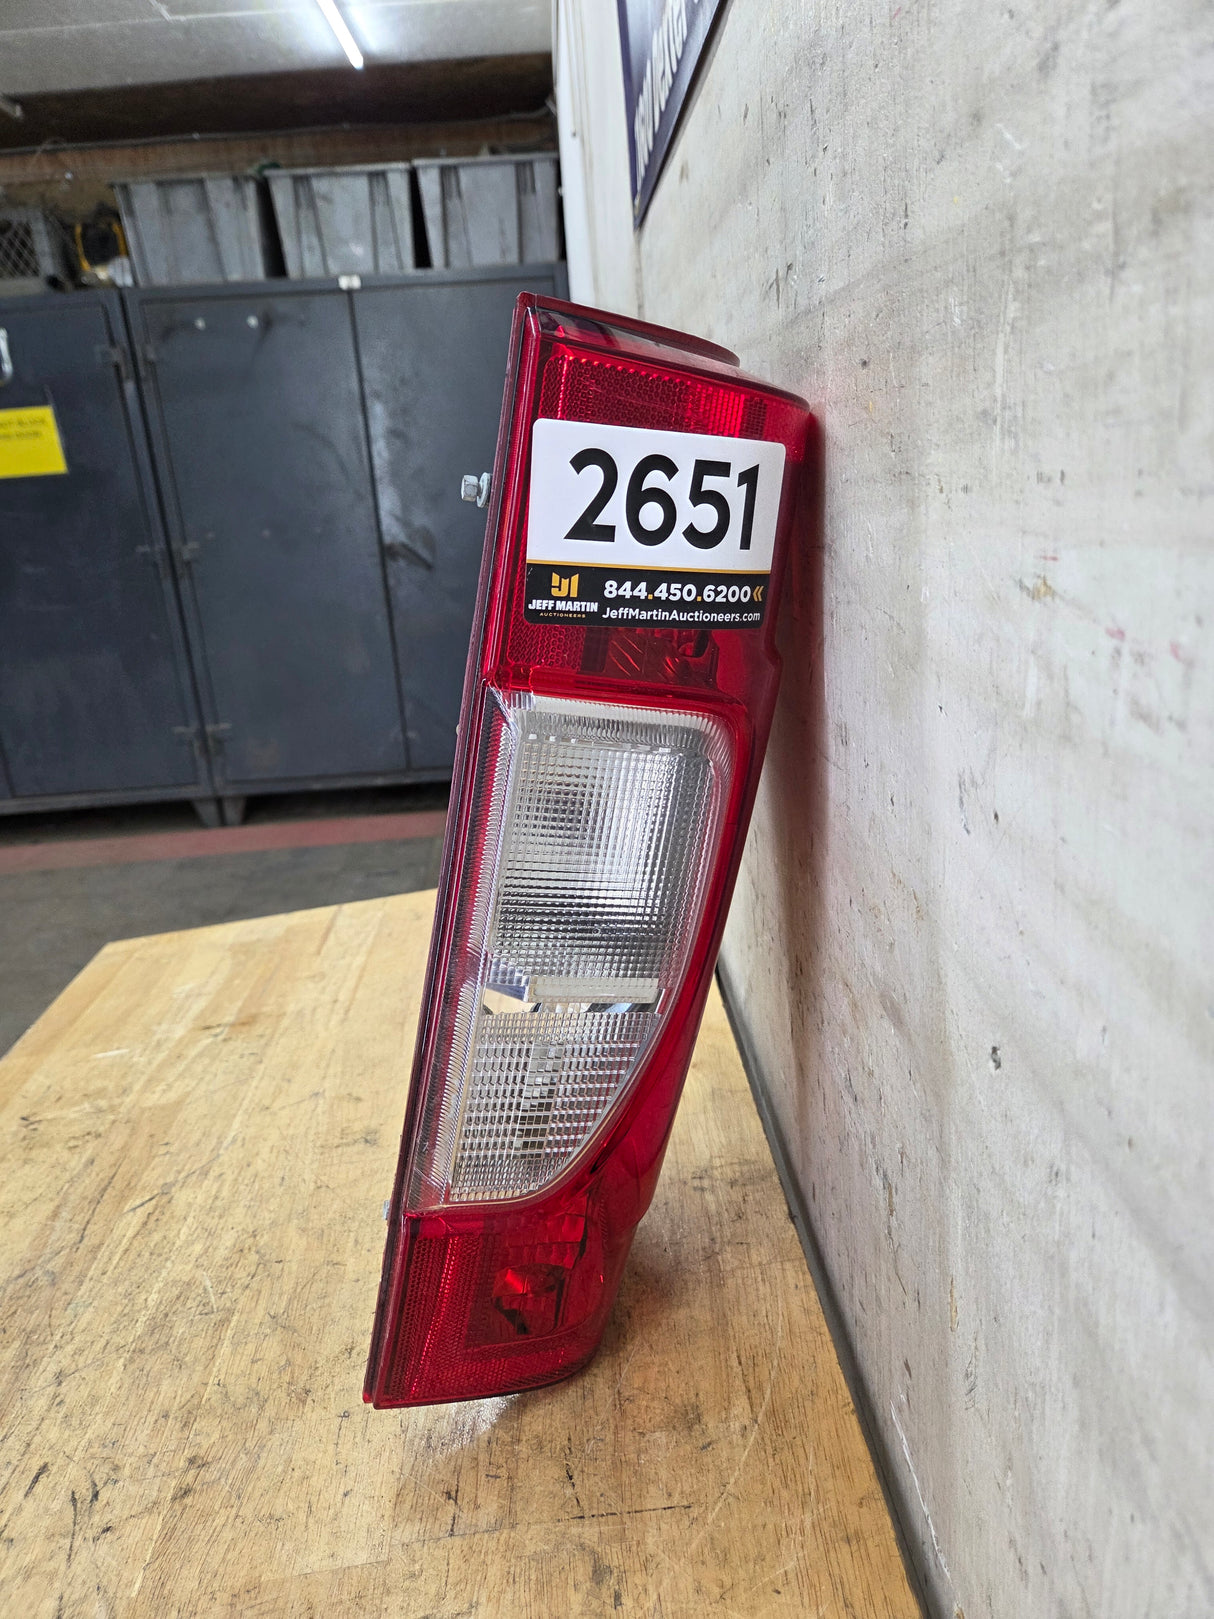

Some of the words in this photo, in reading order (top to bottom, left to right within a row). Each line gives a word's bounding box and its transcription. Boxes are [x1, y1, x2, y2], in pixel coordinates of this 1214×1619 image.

[563, 448, 760, 551] 2651
[603, 580, 751, 603] 844.450.6200
[528, 599, 555, 610] JEFF
[555, 600, 599, 612] MARTIN
[602, 607, 761, 622] JeffMartinAuctioneers.com
